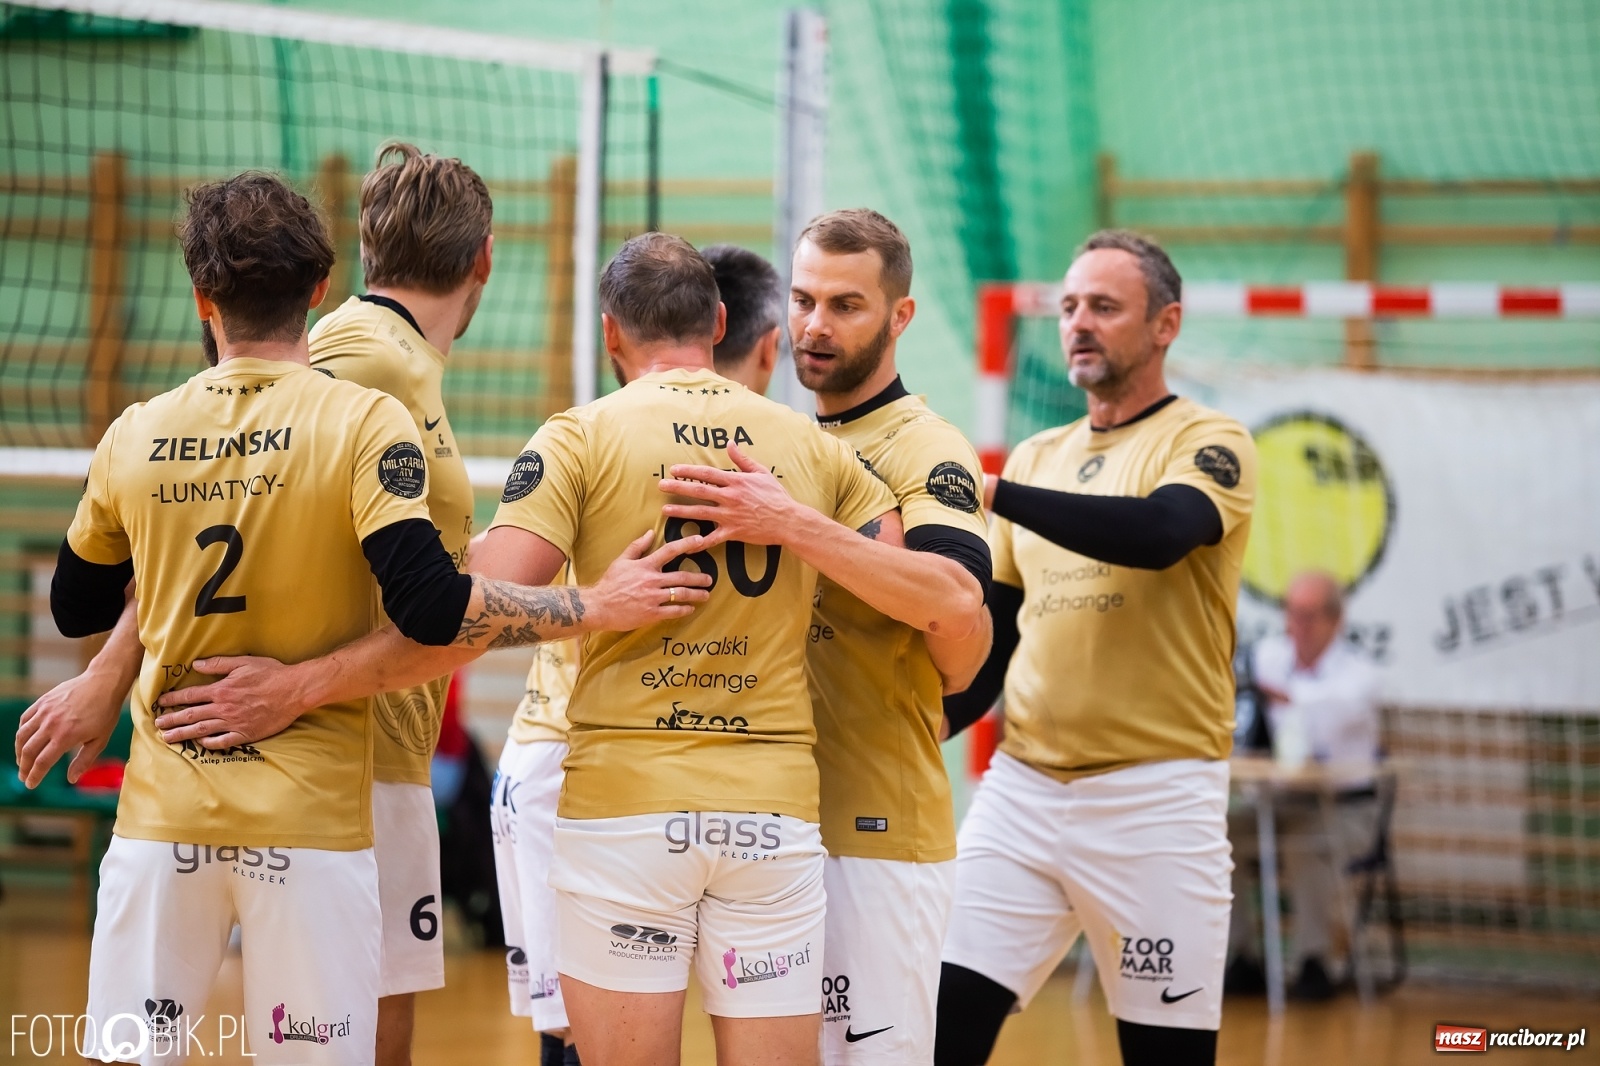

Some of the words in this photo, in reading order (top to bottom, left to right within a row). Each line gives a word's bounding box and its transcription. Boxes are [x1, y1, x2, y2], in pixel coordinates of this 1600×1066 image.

[149, 427, 291, 461] ZIELIŃSKI
[673, 423, 754, 449] KUBA
[382, 457, 424, 470] MILITARIA
[151, 474, 284, 503] -LUNATYCY-
[930, 474, 974, 493] MILITARIA
[194, 524, 247, 618] 2
[1041, 562, 1111, 585] Towalski
[1433, 563, 1567, 652] JEST
[662, 636, 749, 656] Towalski
[641, 665, 758, 693] eXchange
[223, 755, 266, 763] zoologiczny
[665, 811, 781, 854] glass
[721, 850, 778, 860] KŁOSEK
[233, 866, 286, 885] KŁOSEK
[409, 895, 438, 941] 6
[608, 949, 647, 961] PRODUCENT
[1122, 937, 1174, 955] ZOO
[740, 942, 811, 978] kolgraf
[1120, 956, 1173, 974] MAR
[822, 975, 850, 995] OO
[821, 995, 851, 1014] AR
[288, 1014, 351, 1045] kolgraf
